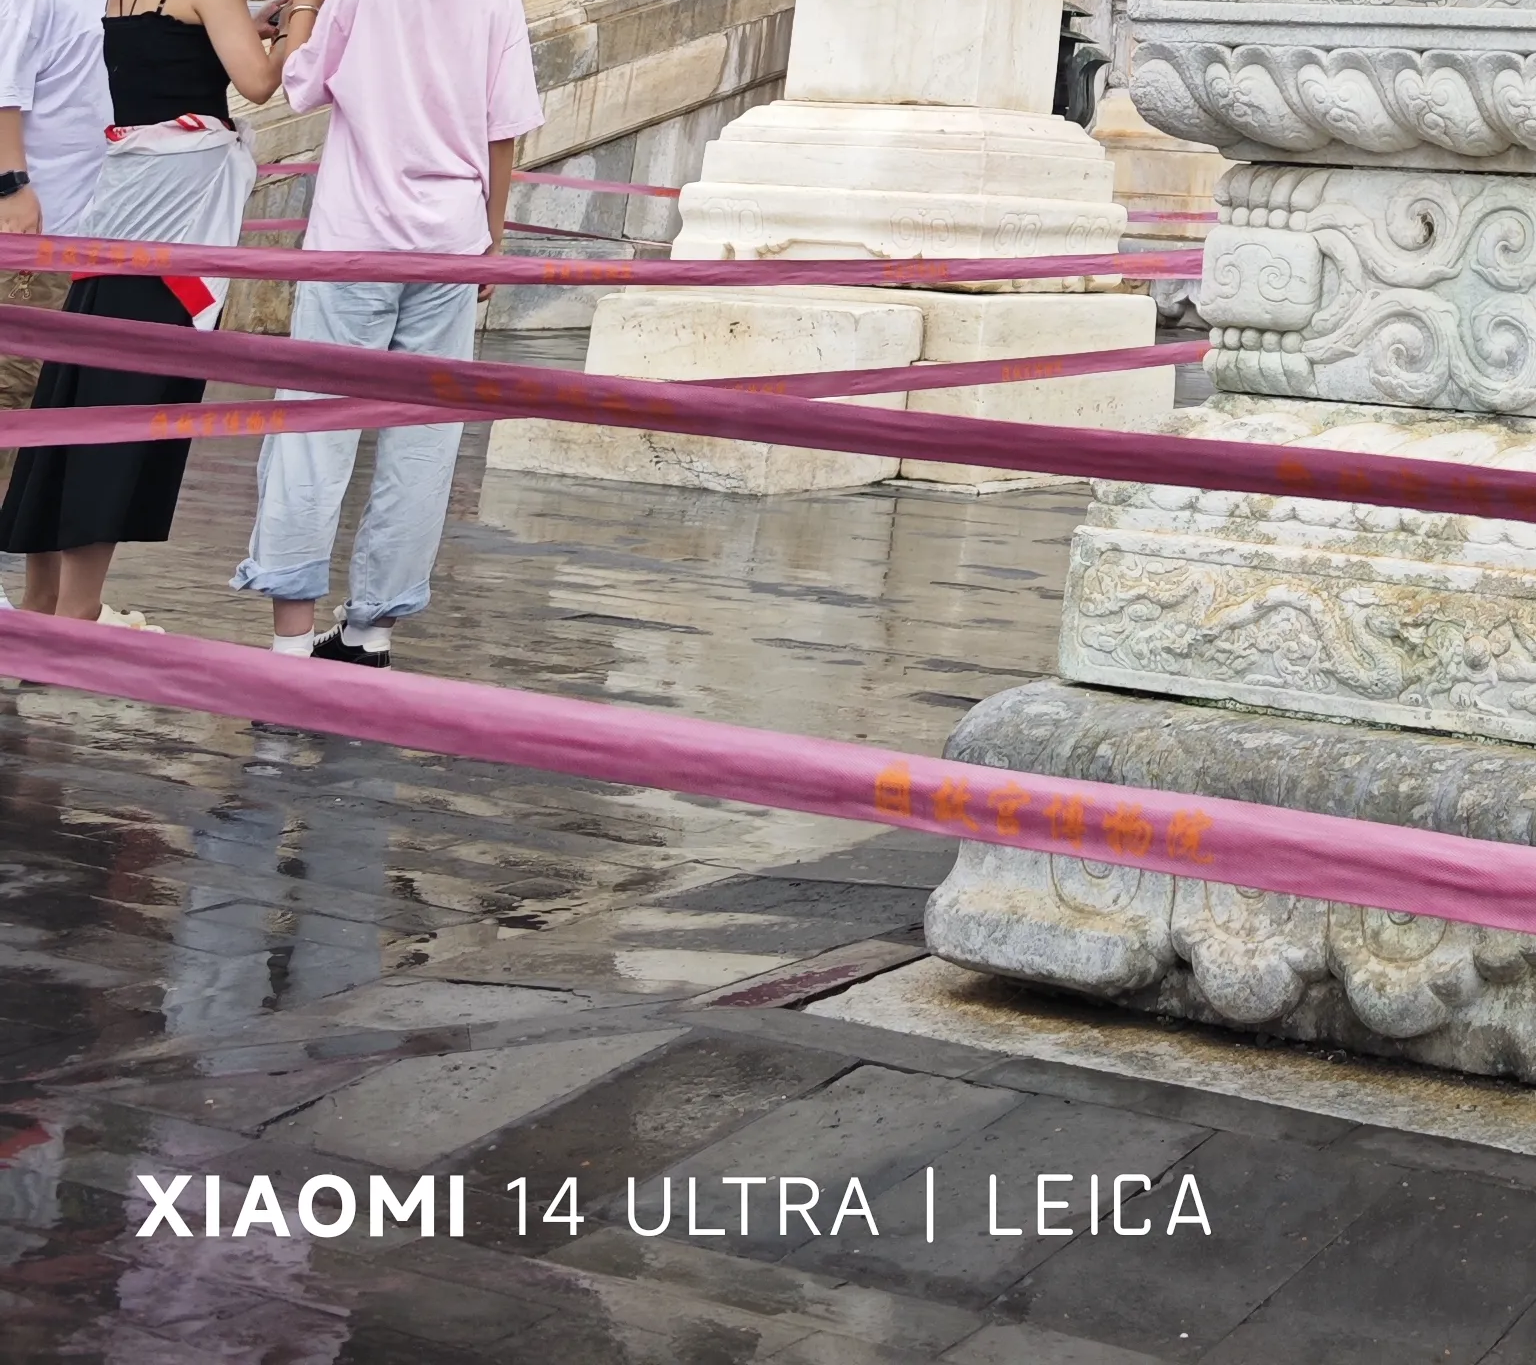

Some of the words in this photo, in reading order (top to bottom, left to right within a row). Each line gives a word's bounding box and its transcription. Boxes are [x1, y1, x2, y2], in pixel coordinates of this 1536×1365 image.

[930, 774, 1215, 865] 故宫博物院
